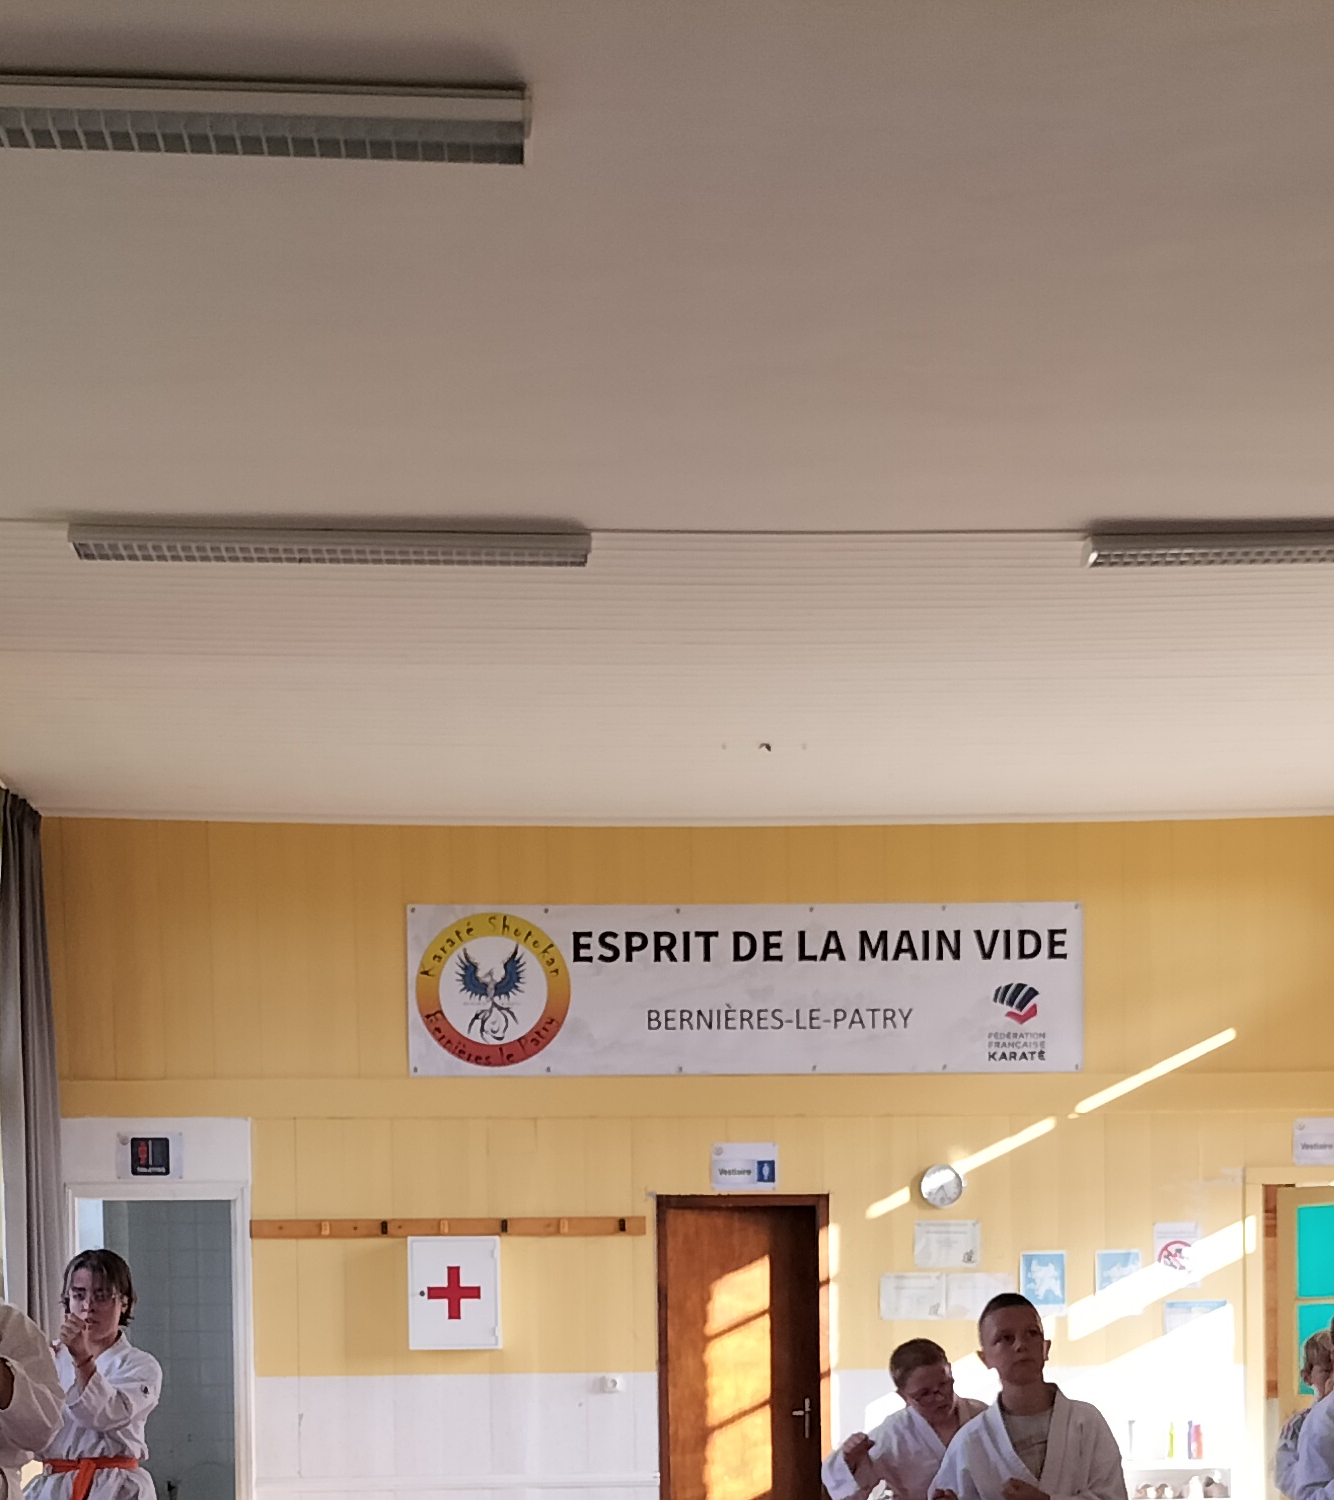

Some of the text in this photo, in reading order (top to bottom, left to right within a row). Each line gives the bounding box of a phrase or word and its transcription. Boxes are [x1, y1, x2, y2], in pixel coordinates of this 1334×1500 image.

[572, 928, 1068, 964] ESPRIT DE LA MAIN VIDE
[647, 1003, 914, 1031] BERNIÈRES-LE-PATRY
[987, 1031, 1046, 1040] FÉDÉRATION
[987, 1040, 1046, 1050] FRANÇAISE
[987, 1049, 1046, 1062] KARATÉ
[717, 1168, 752, 1176] Vestiaire
